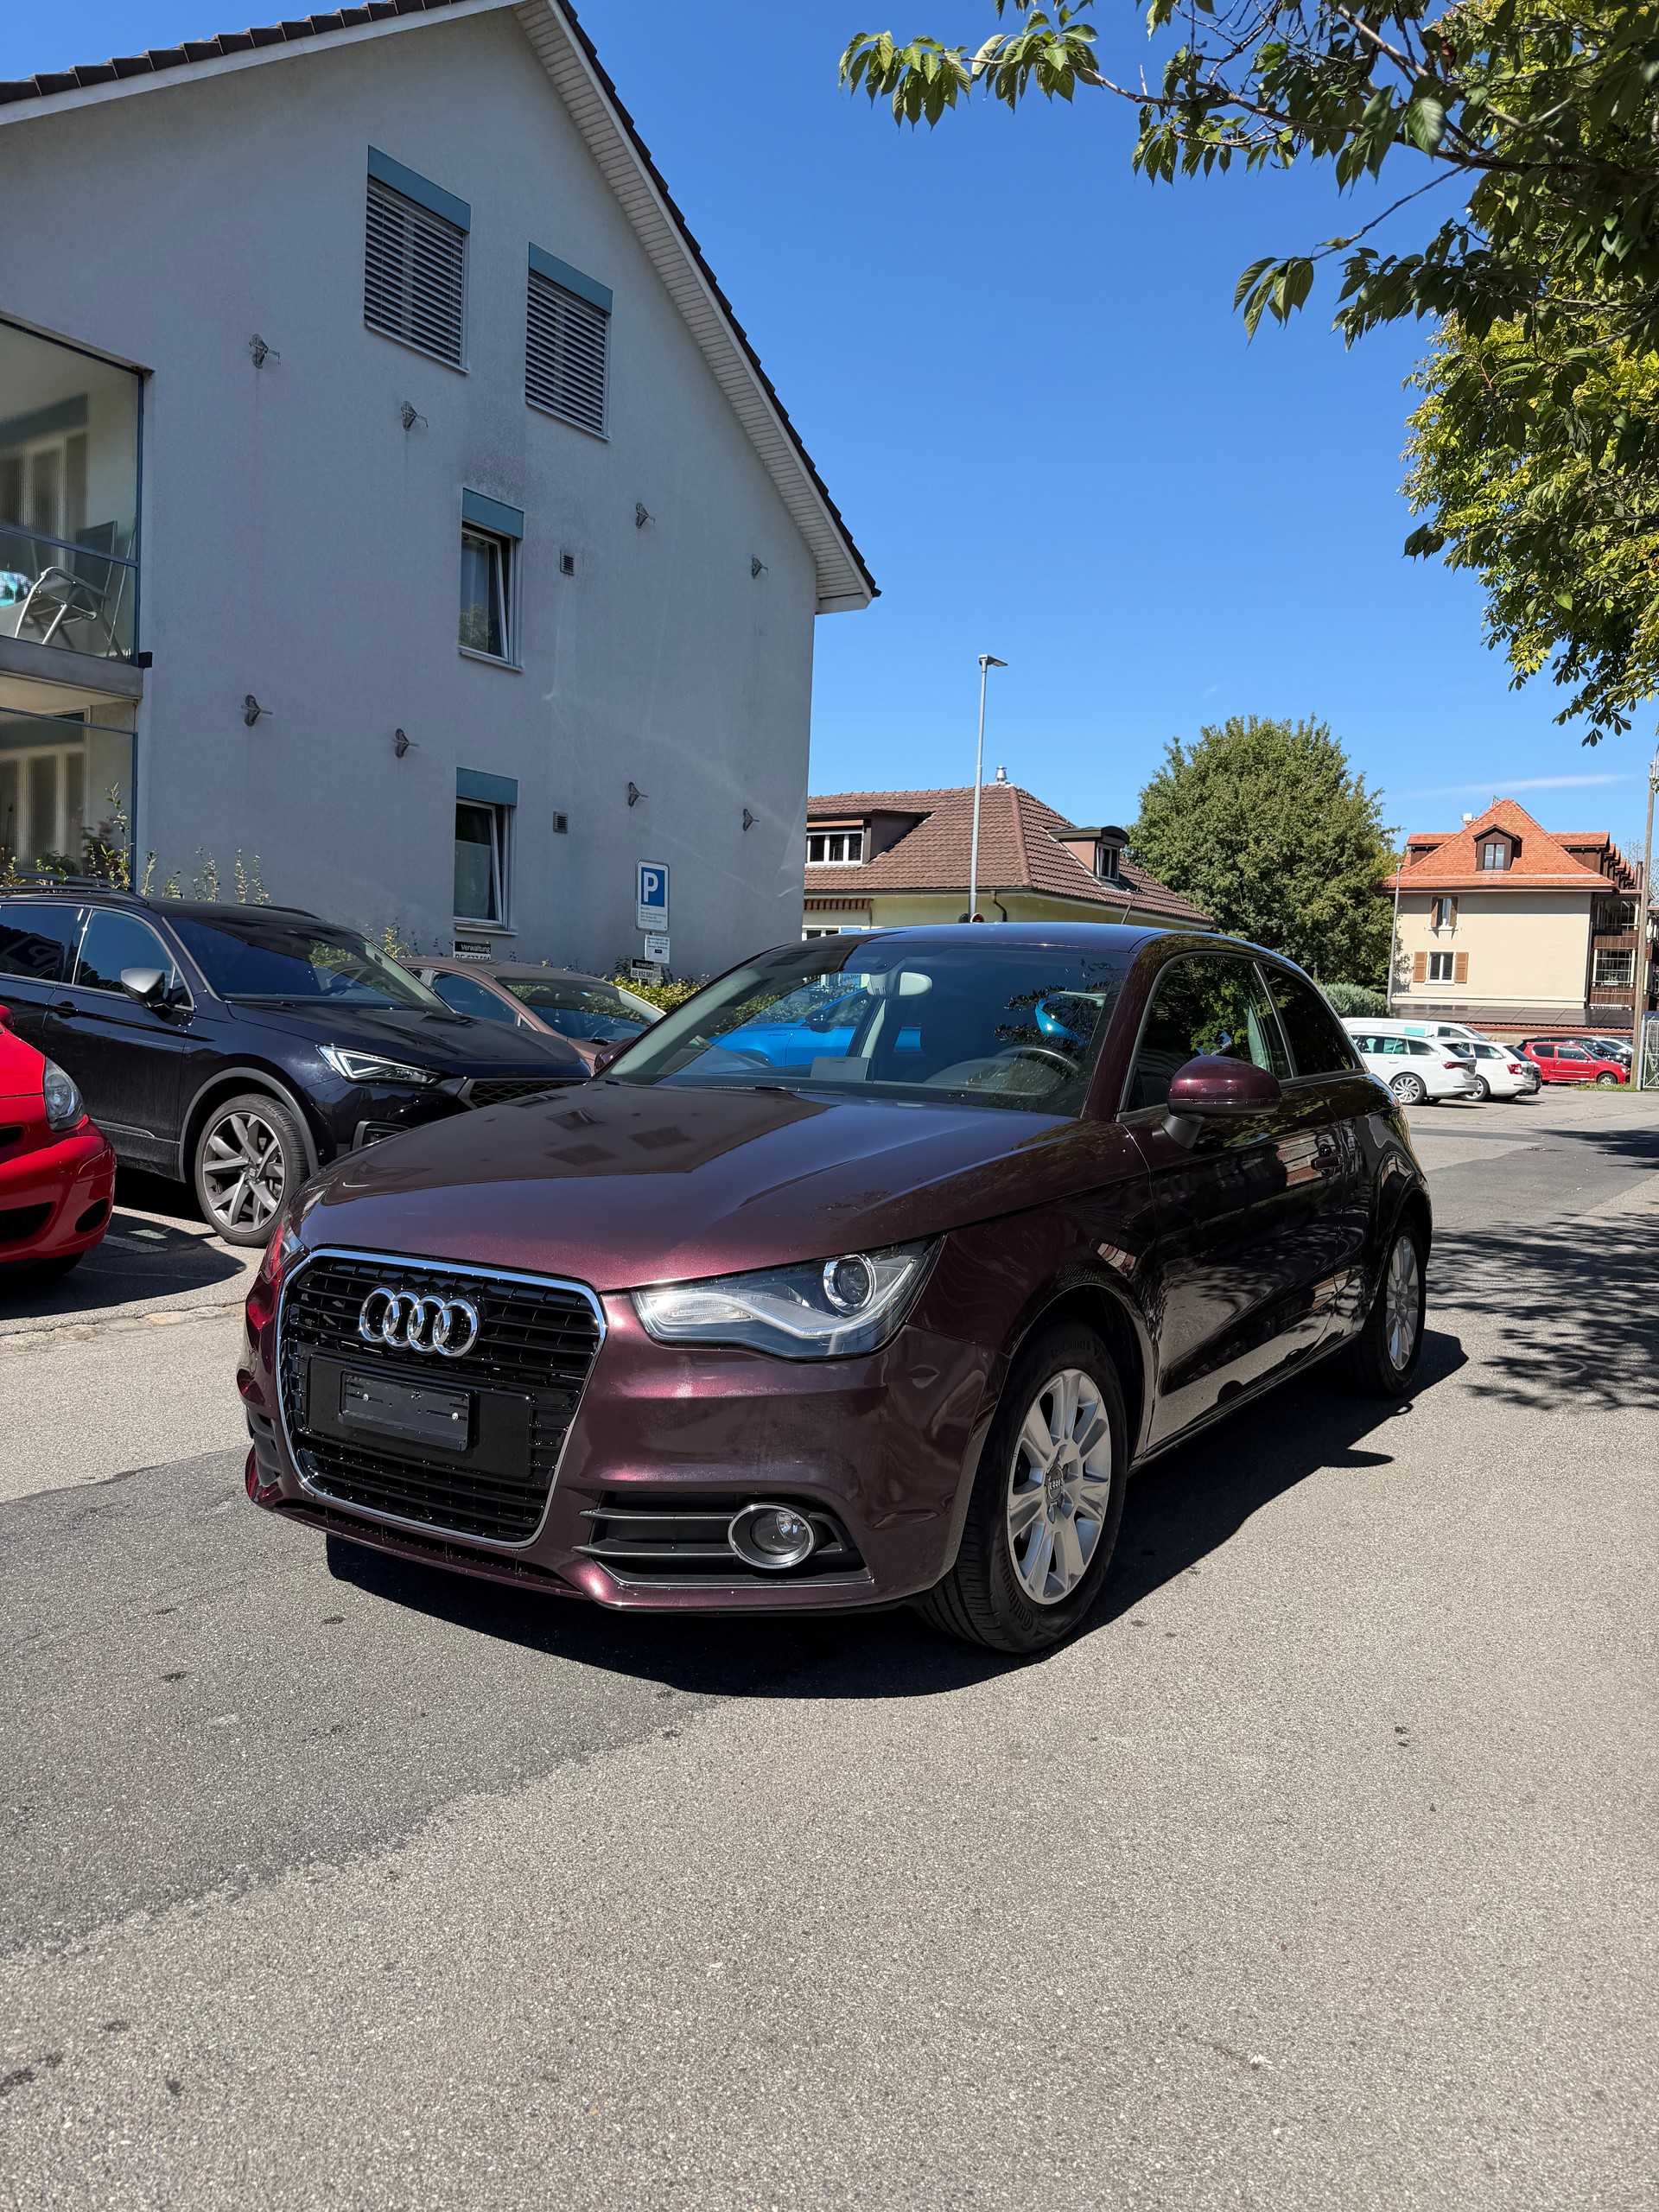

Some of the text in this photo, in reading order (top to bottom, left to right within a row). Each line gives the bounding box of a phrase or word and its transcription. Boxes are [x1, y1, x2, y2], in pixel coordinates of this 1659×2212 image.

[644, 871, 658, 902] P
[461, 944, 490, 953] Verwaltung
[635, 961, 654, 970] Verwaltung
